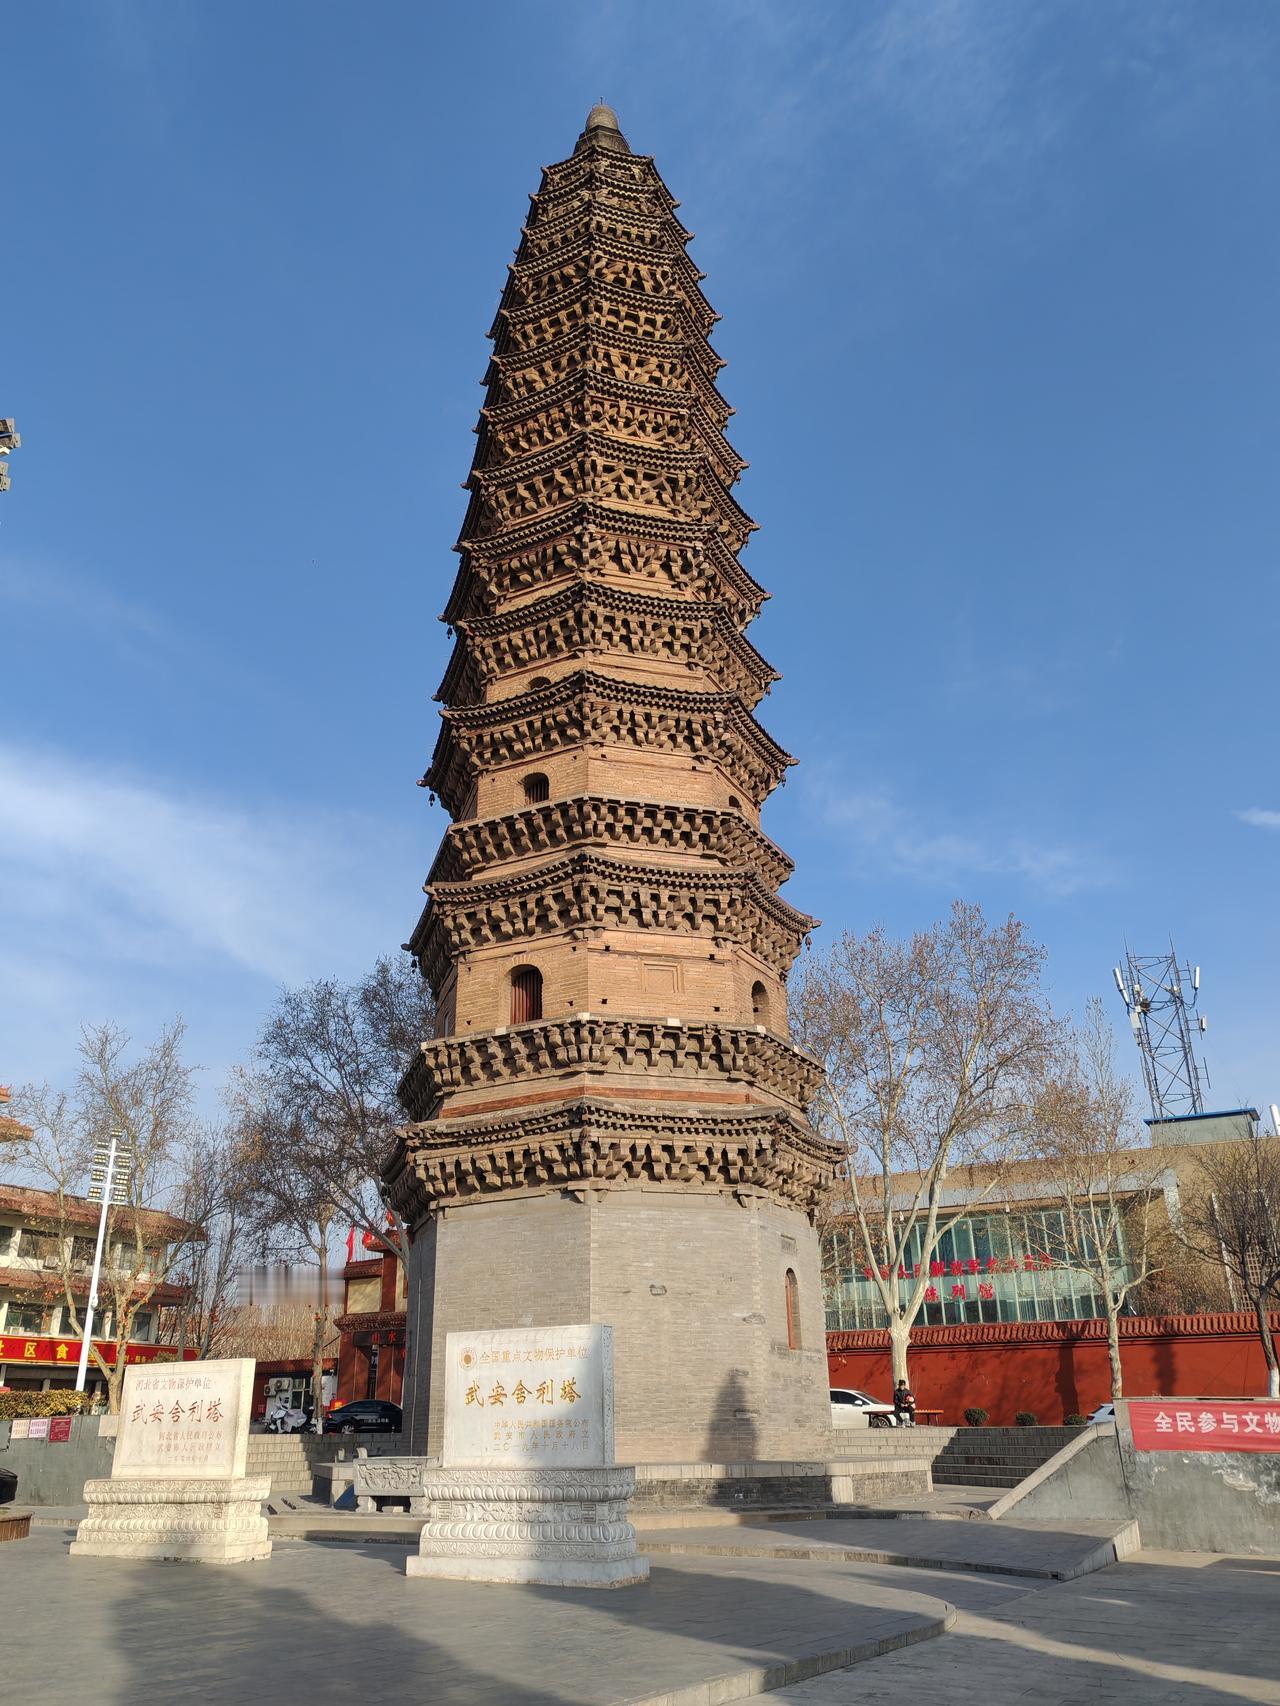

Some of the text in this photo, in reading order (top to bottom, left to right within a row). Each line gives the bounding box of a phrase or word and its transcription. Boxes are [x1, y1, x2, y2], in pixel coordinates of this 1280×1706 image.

[480, 1346, 588, 1364] 全国重点文物保护单位
[136, 1377, 212, 1391] 河北省文物保护单位
[464, 1376, 582, 1408] 武安舍利塔
[131, 1397, 224, 1424] 武安舍利塔
[1153, 1411, 1280, 1433] 全民参与文物
[494, 1430, 590, 1440] 武安市人民政府立
